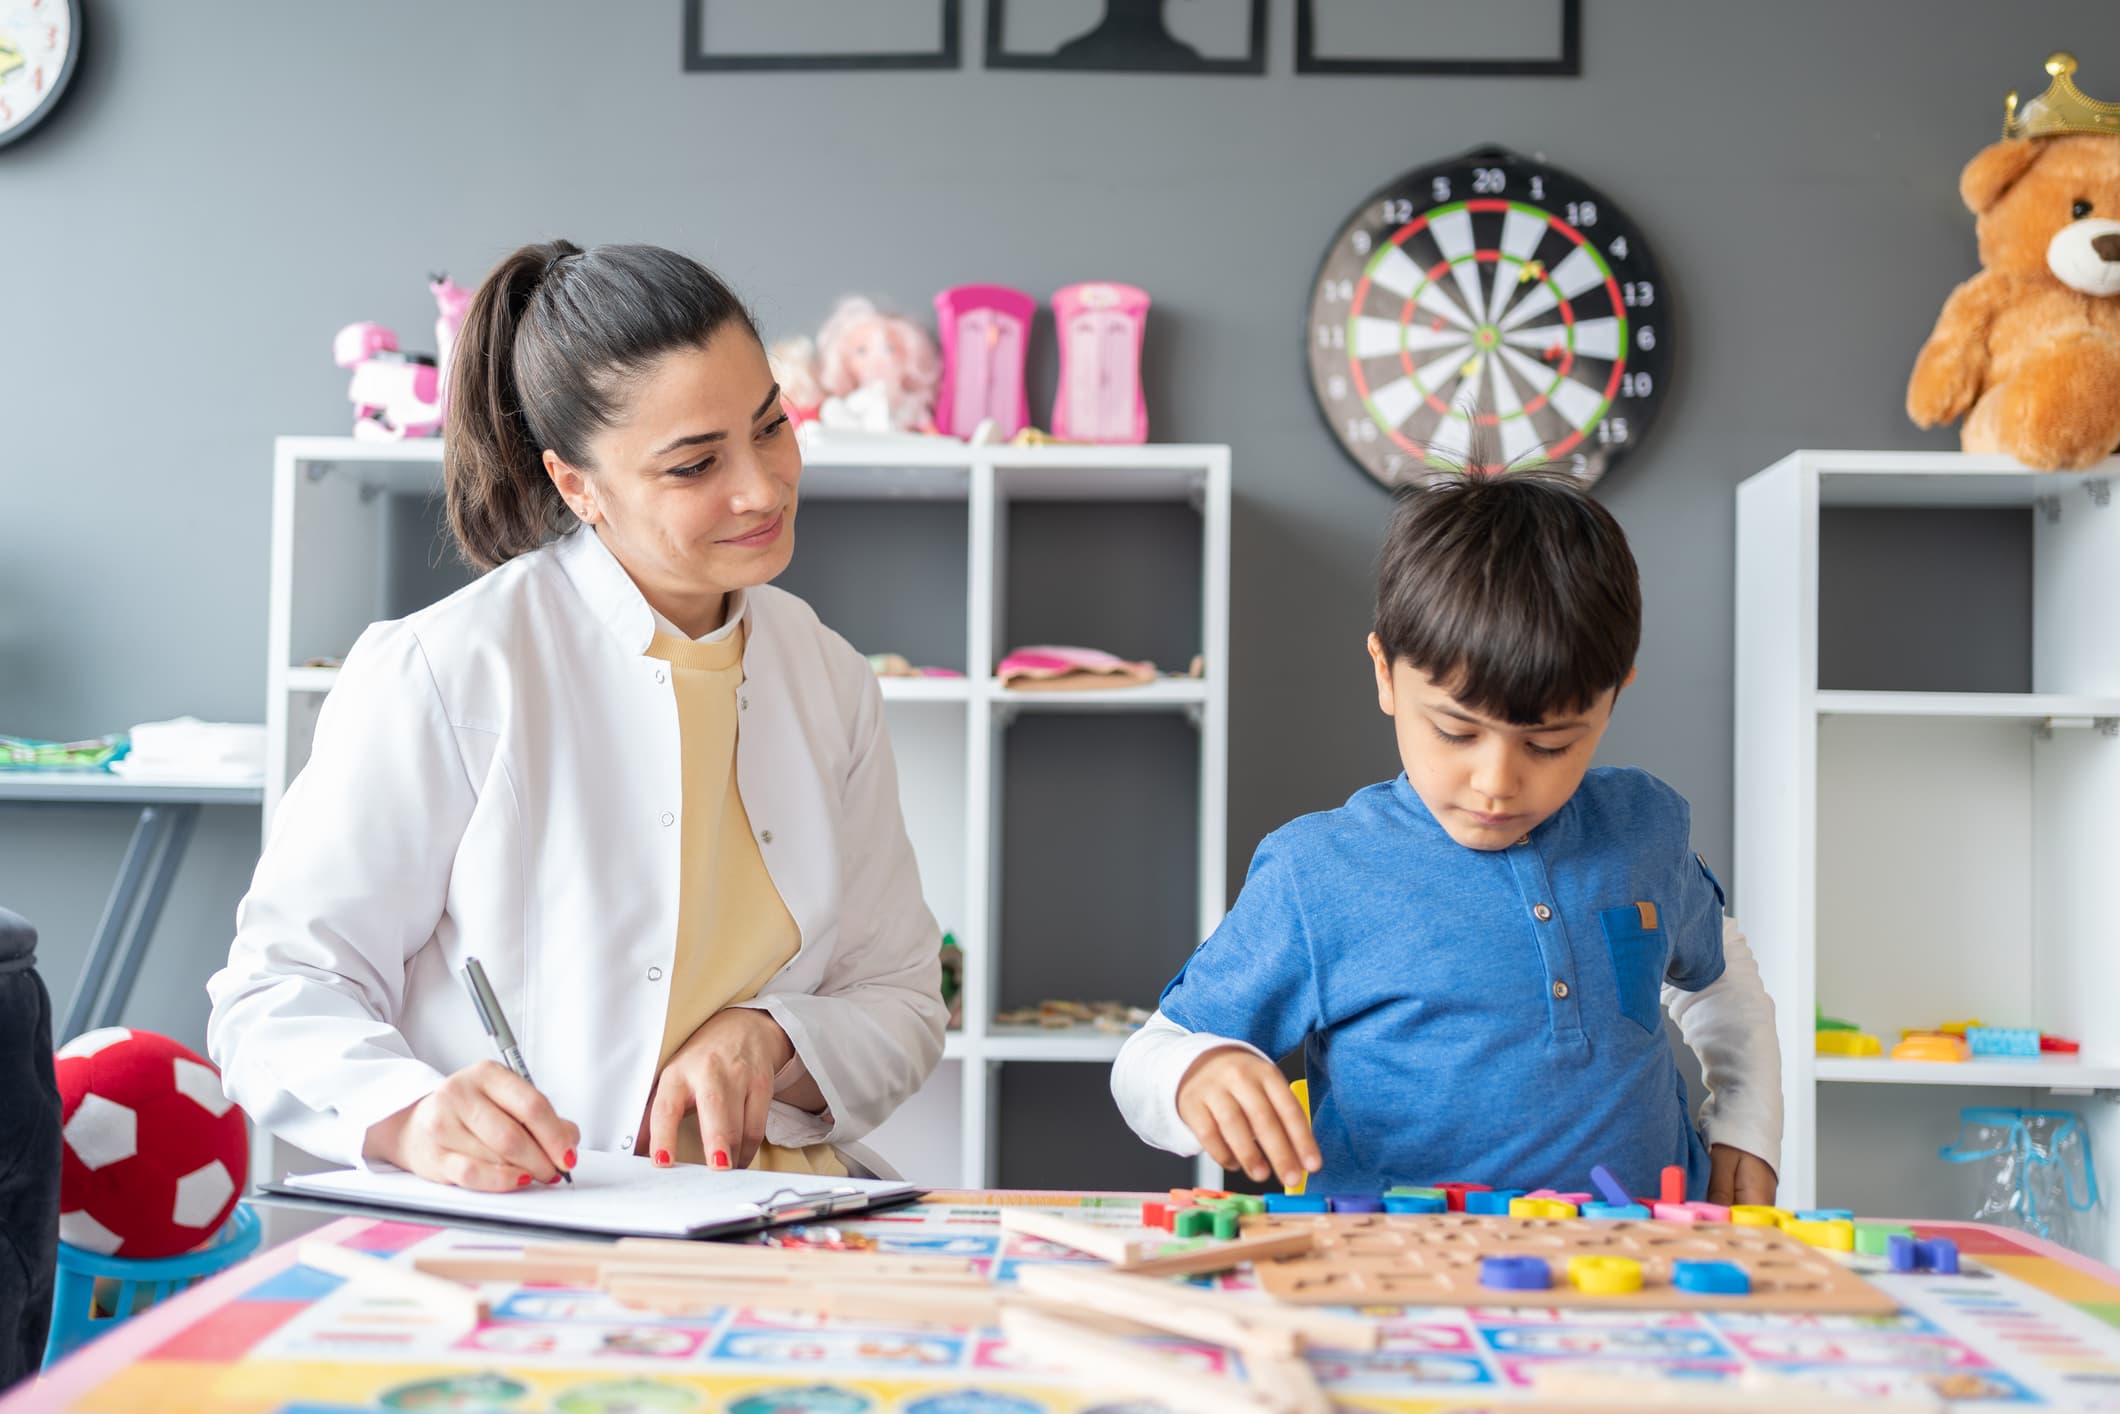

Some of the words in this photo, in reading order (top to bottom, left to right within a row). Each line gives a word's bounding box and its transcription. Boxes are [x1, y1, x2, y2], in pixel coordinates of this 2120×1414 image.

[1432, 176, 1451, 202] 5
[1472, 167, 1506, 194] 20
[1529, 175, 1546, 200] 1
[1383, 199, 1413, 224] 12
[1566, 201, 1597, 226] 18
[1352, 230, 1372, 256] 9
[1608, 235, 1628, 260] 4
[1323, 279, 1353, 303] 14
[1624, 281, 1654, 307] 13
[1318, 324, 1345, 348] 11
[1636, 325, 1656, 351] 6
[1623, 372, 1653, 398] 10
[1598, 418, 1628, 443] 15
